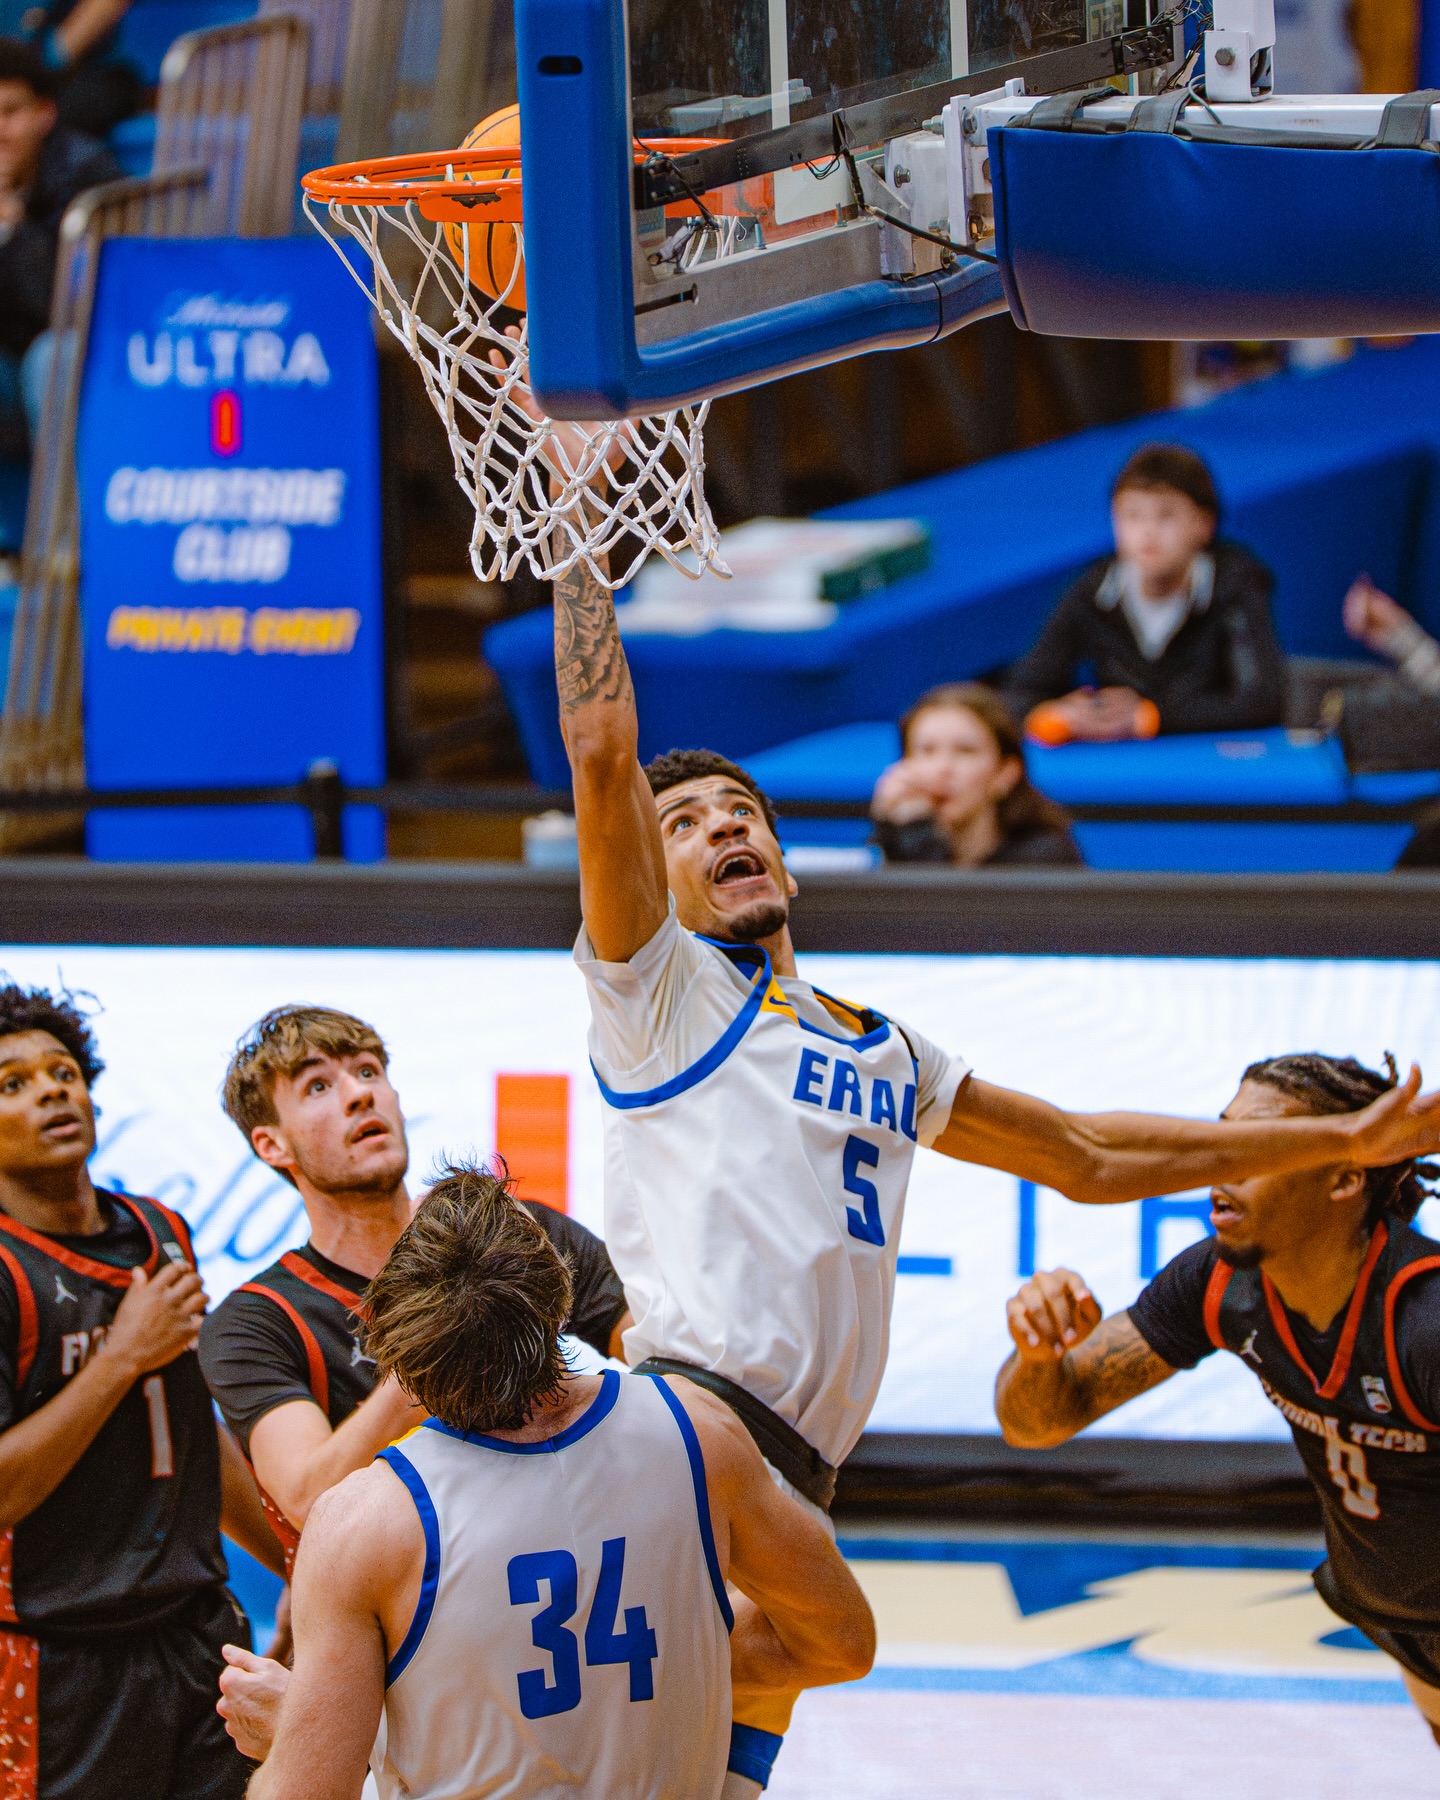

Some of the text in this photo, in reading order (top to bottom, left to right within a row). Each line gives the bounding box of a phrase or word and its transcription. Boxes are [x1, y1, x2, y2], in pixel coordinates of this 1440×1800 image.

[127, 329, 330, 387] ULTRA
[105, 466, 346, 526] COURTSIDE
[173, 523, 292, 583] CLUB
[843, 1134, 885, 1247] 5
[143, 1374, 174, 1478] 1
[1326, 1438, 1381, 1521] 0
[507, 1536, 658, 1720] 34
